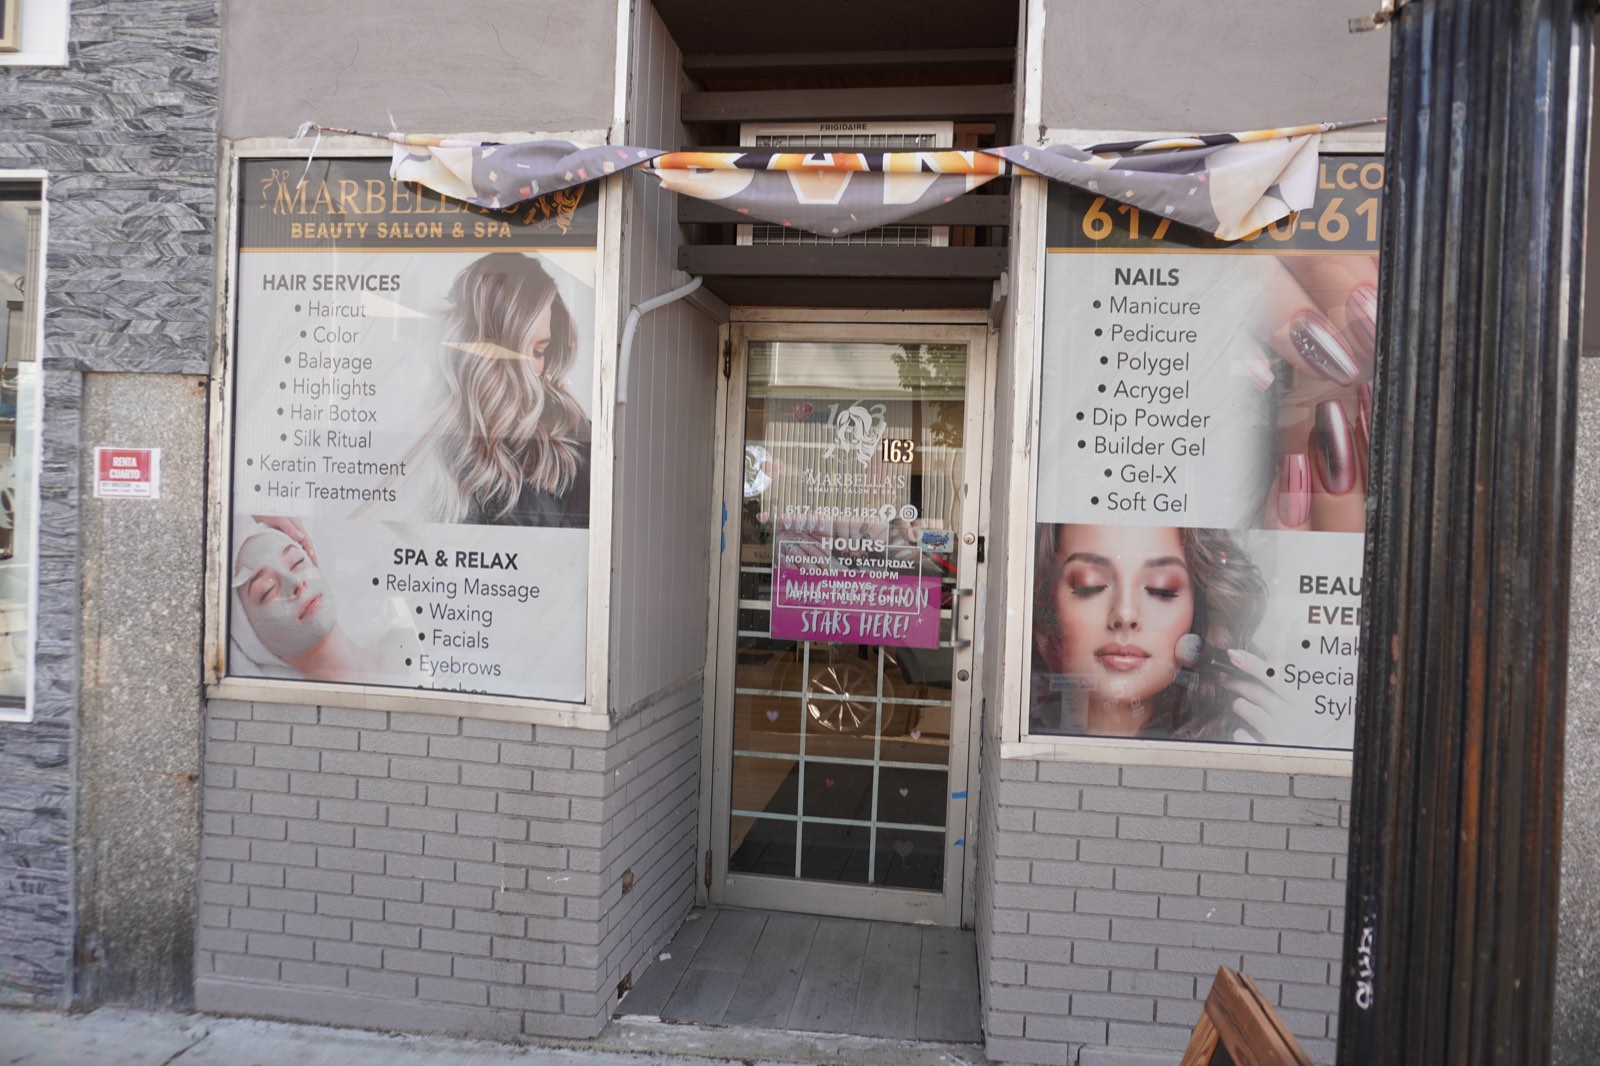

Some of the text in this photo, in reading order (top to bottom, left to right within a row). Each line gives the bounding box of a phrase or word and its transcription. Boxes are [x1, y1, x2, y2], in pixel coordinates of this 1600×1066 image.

[291, 222, 512, 239] BEAUTY SALON & SPA
[262, 274, 400, 292] HAIR SERVICES
[1114, 268, 1180, 286] NAILS
[308, 300, 366, 318] Haircut
[1110, 296, 1200, 315] Manicure
[313, 326, 359, 343] Color
[1112, 323, 1197, 343] Pedicure
[298, 351, 372, 374] Balayage
[1117, 352, 1190, 376] Polygel
[293, 378, 376, 400] Highlights
[1114, 380, 1190, 404] Acrygel
[290, 404, 377, 422] Hair Botox
[1093, 407, 1211, 432] Dip Powder
[294, 428, 372, 449] Silk Ritual
[1094, 435, 1206, 456] Builder Gel
[882, 438, 915, 464] 163
[260, 454, 406, 476] Keratin Treatment
[1120, 464, 1177, 484] Gel-X
[807, 472, 905, 488] MARBELLA'S
[268, 480, 396, 502] Hair Treatments
[786, 504, 878, 518] 617 480-6182
[1108, 492, 1188, 512] Soft Gel
[821, 537, 885, 552] HOURS
[394, 548, 518, 570] SPA & RELAX
[786, 555, 914, 569] MONDAY TO SATURDAY
[843, 570, 856, 578] TO
[386, 574, 540, 602] Relaxing Massage
[430, 602, 493, 628] Waxing
[801, 610, 910, 638] STARS HERE!
[432, 629, 490, 650] Facials
[419, 654, 502, 677] Eyebrows
